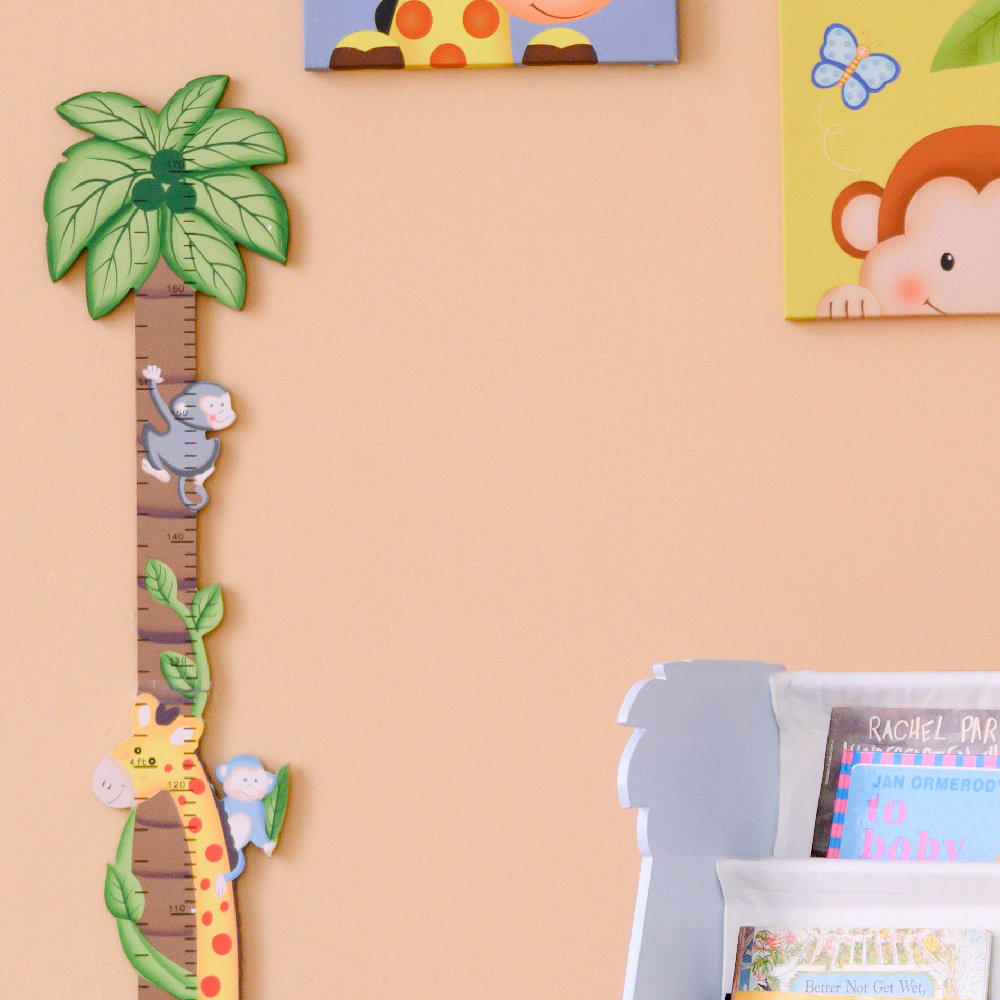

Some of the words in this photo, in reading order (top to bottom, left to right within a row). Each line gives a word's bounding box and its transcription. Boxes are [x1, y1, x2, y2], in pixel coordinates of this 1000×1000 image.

[166, 161, 185, 169] 170
[167, 284, 184, 292] 160
[167, 533, 184, 541] 140
[868, 715, 947, 743] RACHEL
[168, 780, 185, 789] 120
[872, 774, 905, 790] JAN
[867, 792, 908, 825] to
[861, 828, 965, 861] baby
[169, 904, 186, 912] 110
[804, 978, 842, 994] Better
[845, 979, 868, 994] Not
[873, 980, 894, 994] Get
[899, 979, 927, 996] Wet,
